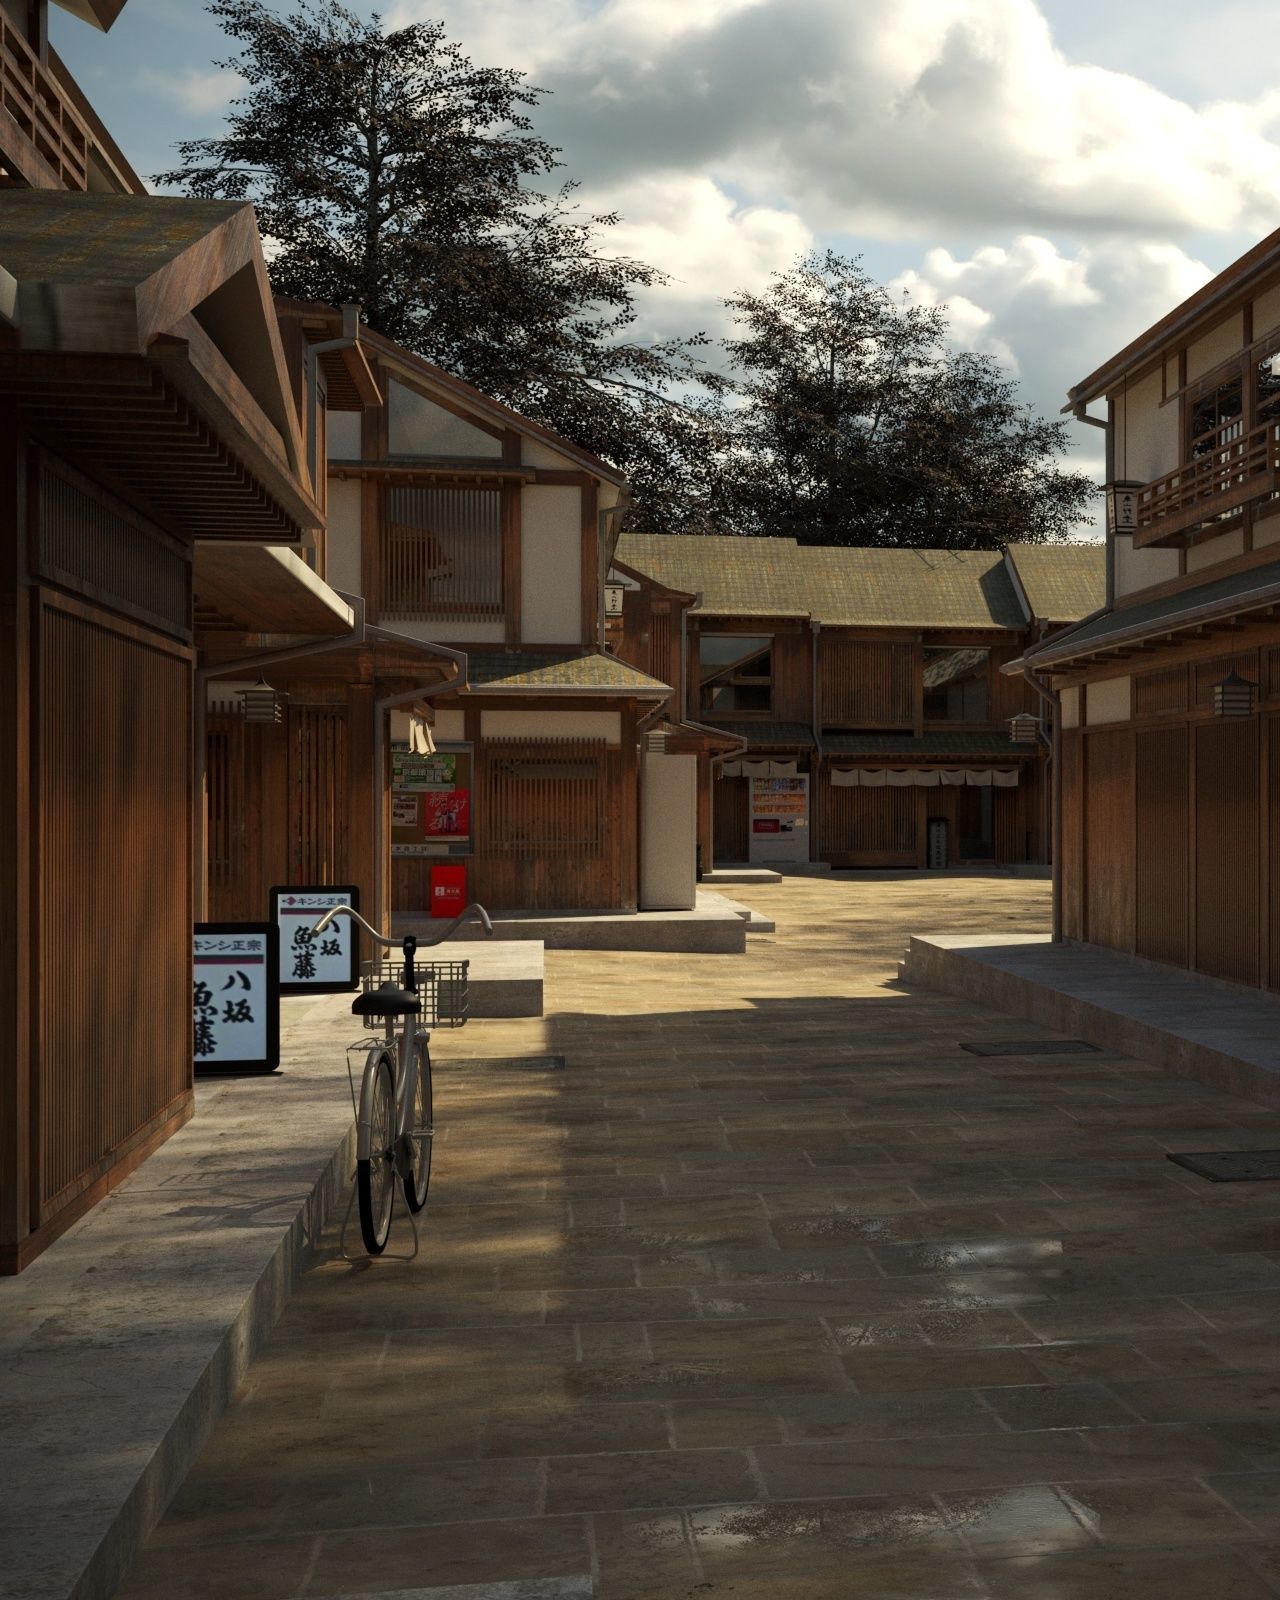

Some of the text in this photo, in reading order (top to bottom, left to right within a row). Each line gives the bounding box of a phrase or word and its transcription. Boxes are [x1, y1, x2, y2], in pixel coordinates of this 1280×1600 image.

[297, 896, 348, 906] キンシ正宗
[290, 925, 317, 980] 魚藤
[221, 970, 255, 1023] 八坂
